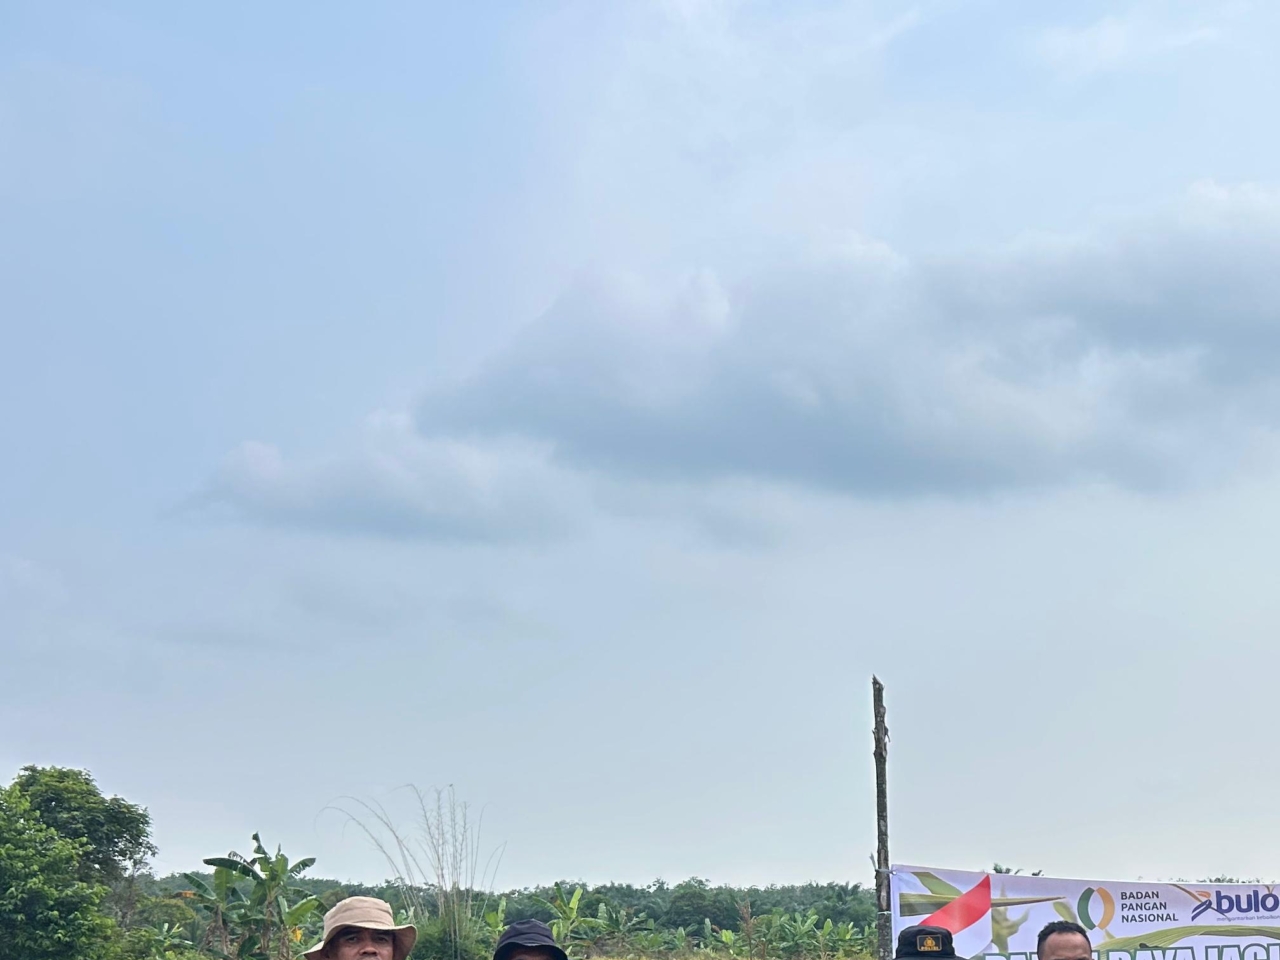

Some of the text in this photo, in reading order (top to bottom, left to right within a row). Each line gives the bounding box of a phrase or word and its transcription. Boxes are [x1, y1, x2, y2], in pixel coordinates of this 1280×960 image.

[1120, 890, 1160, 901] BADAN
[1121, 901, 1167, 912] PANGAN
[1121, 912, 1179, 923] NASIONAL
